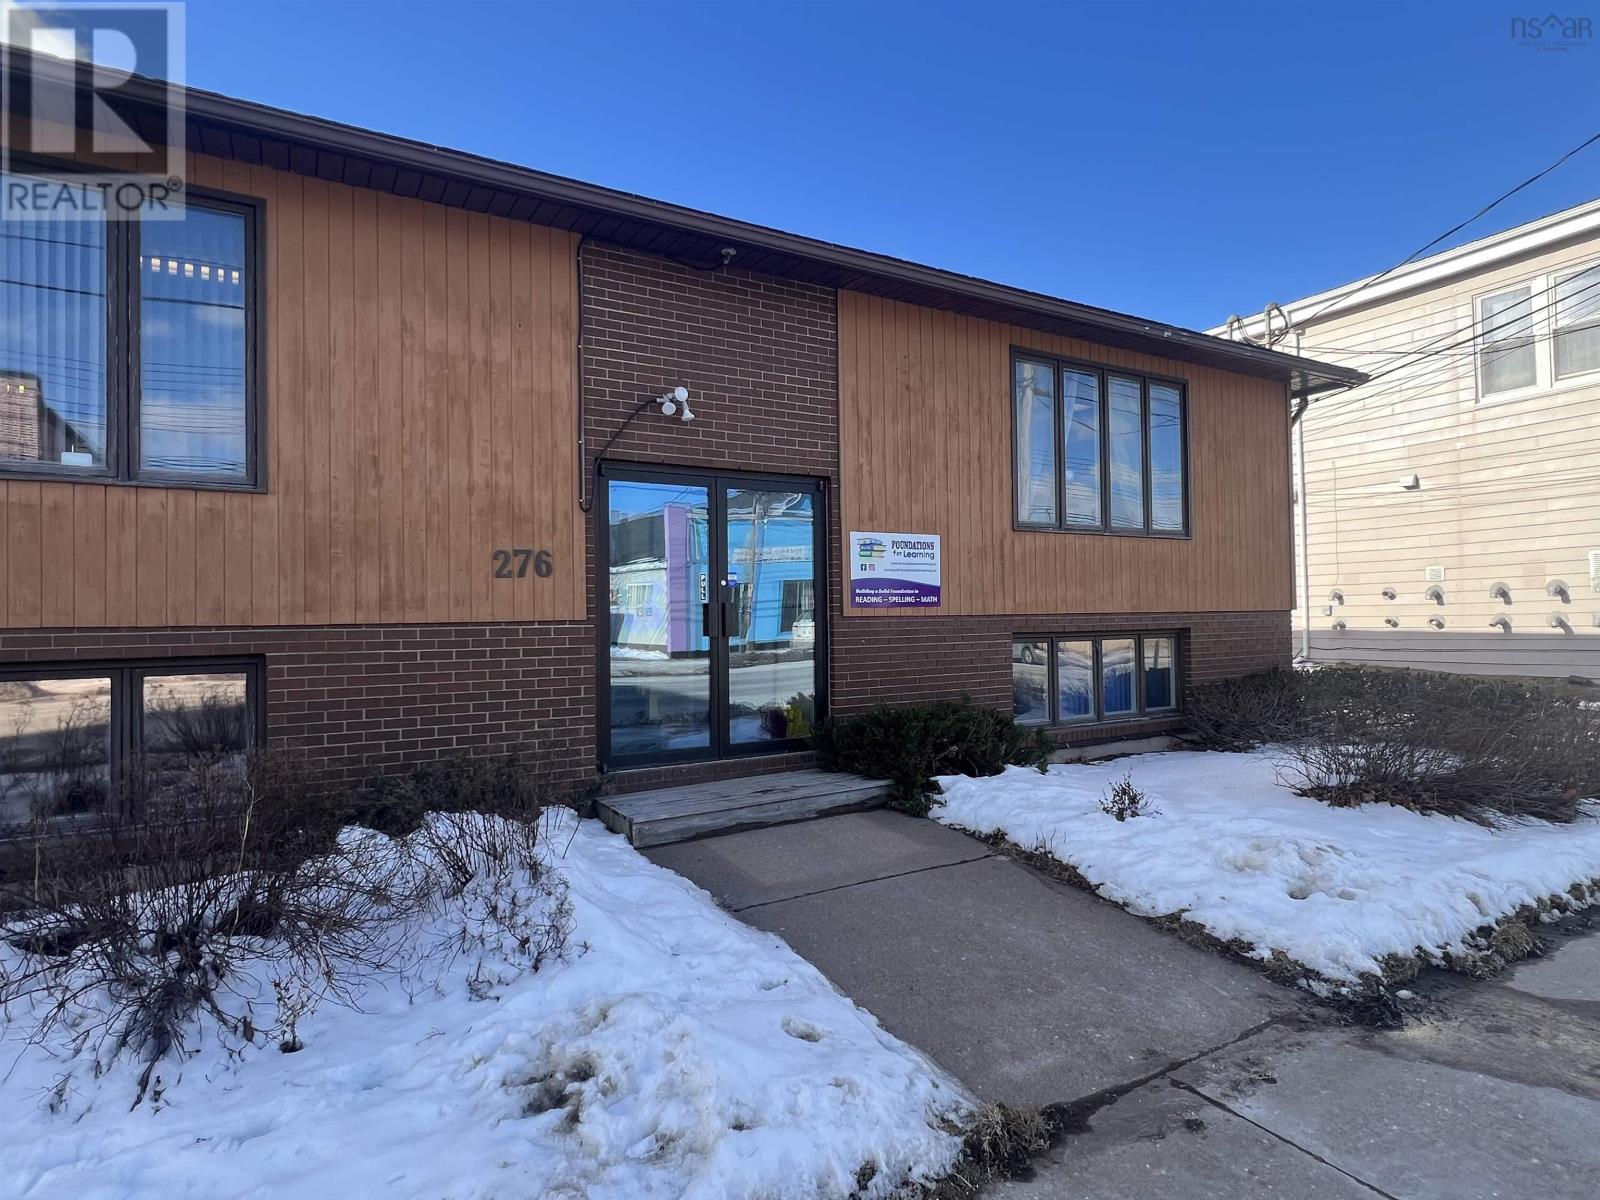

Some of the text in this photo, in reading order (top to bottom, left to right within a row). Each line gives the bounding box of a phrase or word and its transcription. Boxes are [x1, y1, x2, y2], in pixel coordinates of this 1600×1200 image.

[891, 540, 935, 551] FOUNDATIONS
[903, 551, 935, 560] Learning
[492, 549, 553, 578] 276
